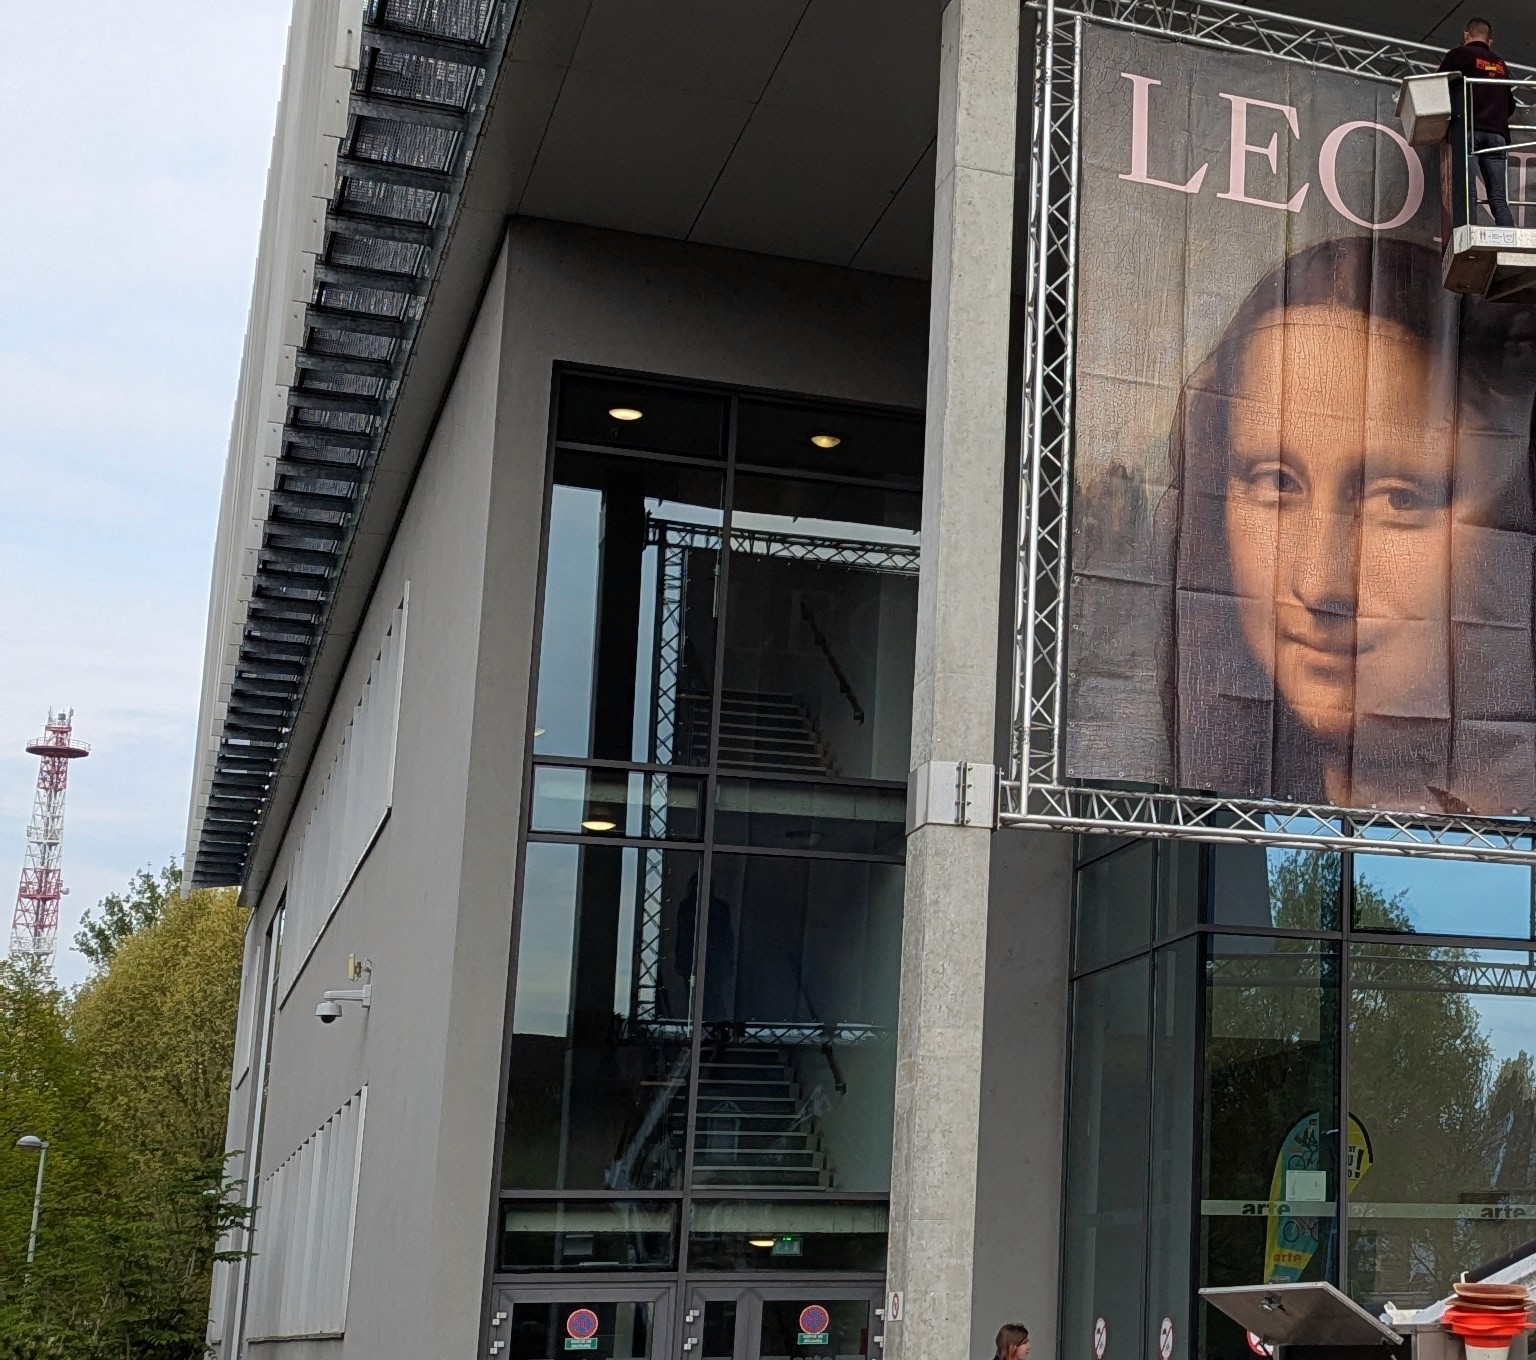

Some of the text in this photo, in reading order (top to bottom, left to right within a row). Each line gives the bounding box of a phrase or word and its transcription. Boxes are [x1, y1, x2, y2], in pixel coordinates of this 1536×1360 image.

[1241, 1201, 1291, 1216] arte
[1480, 1205, 1526, 1219] arte
[1272, 1252, 1303, 1264] arte
